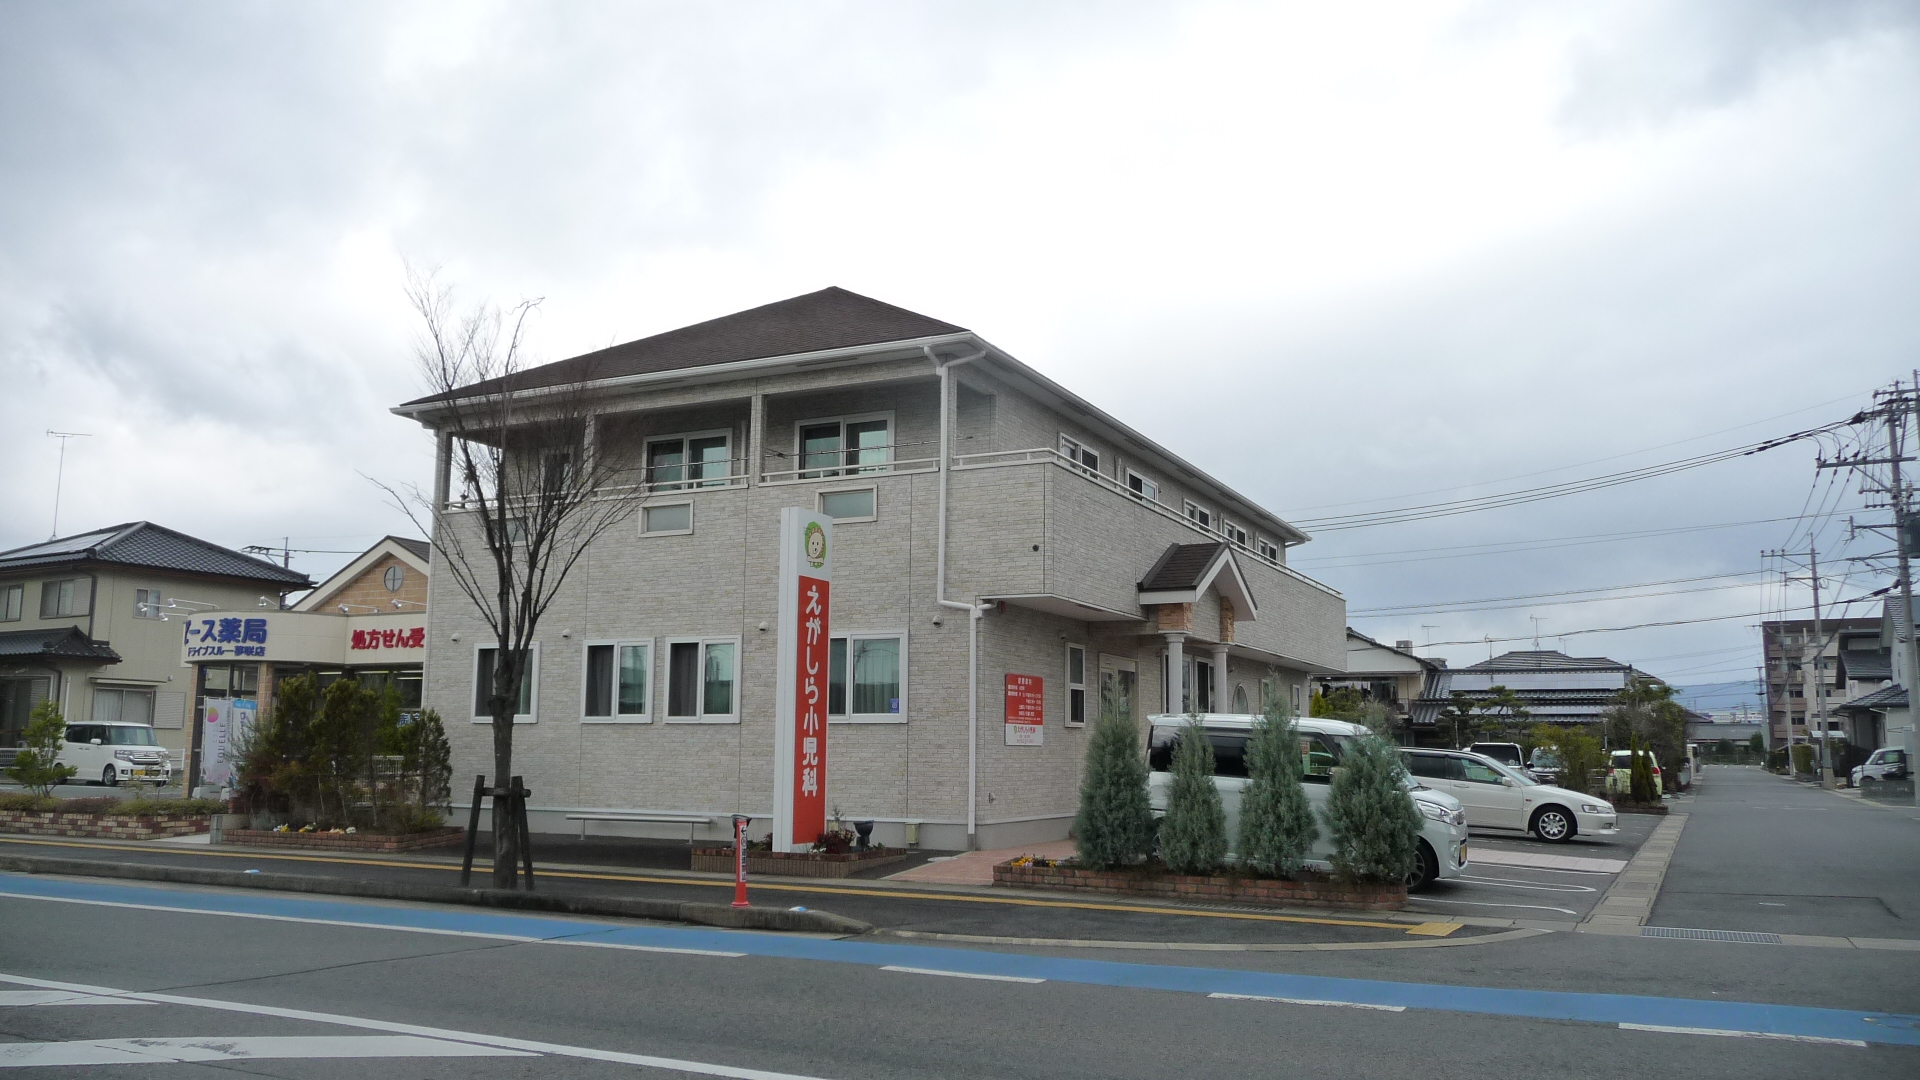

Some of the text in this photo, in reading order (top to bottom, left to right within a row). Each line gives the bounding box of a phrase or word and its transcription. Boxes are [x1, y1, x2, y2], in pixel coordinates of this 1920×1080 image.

[350, 626, 426, 650] 処方せん受
[801, 584, 821, 797] えがしら小児科
[217, 722, 226, 764] EQUELLE
